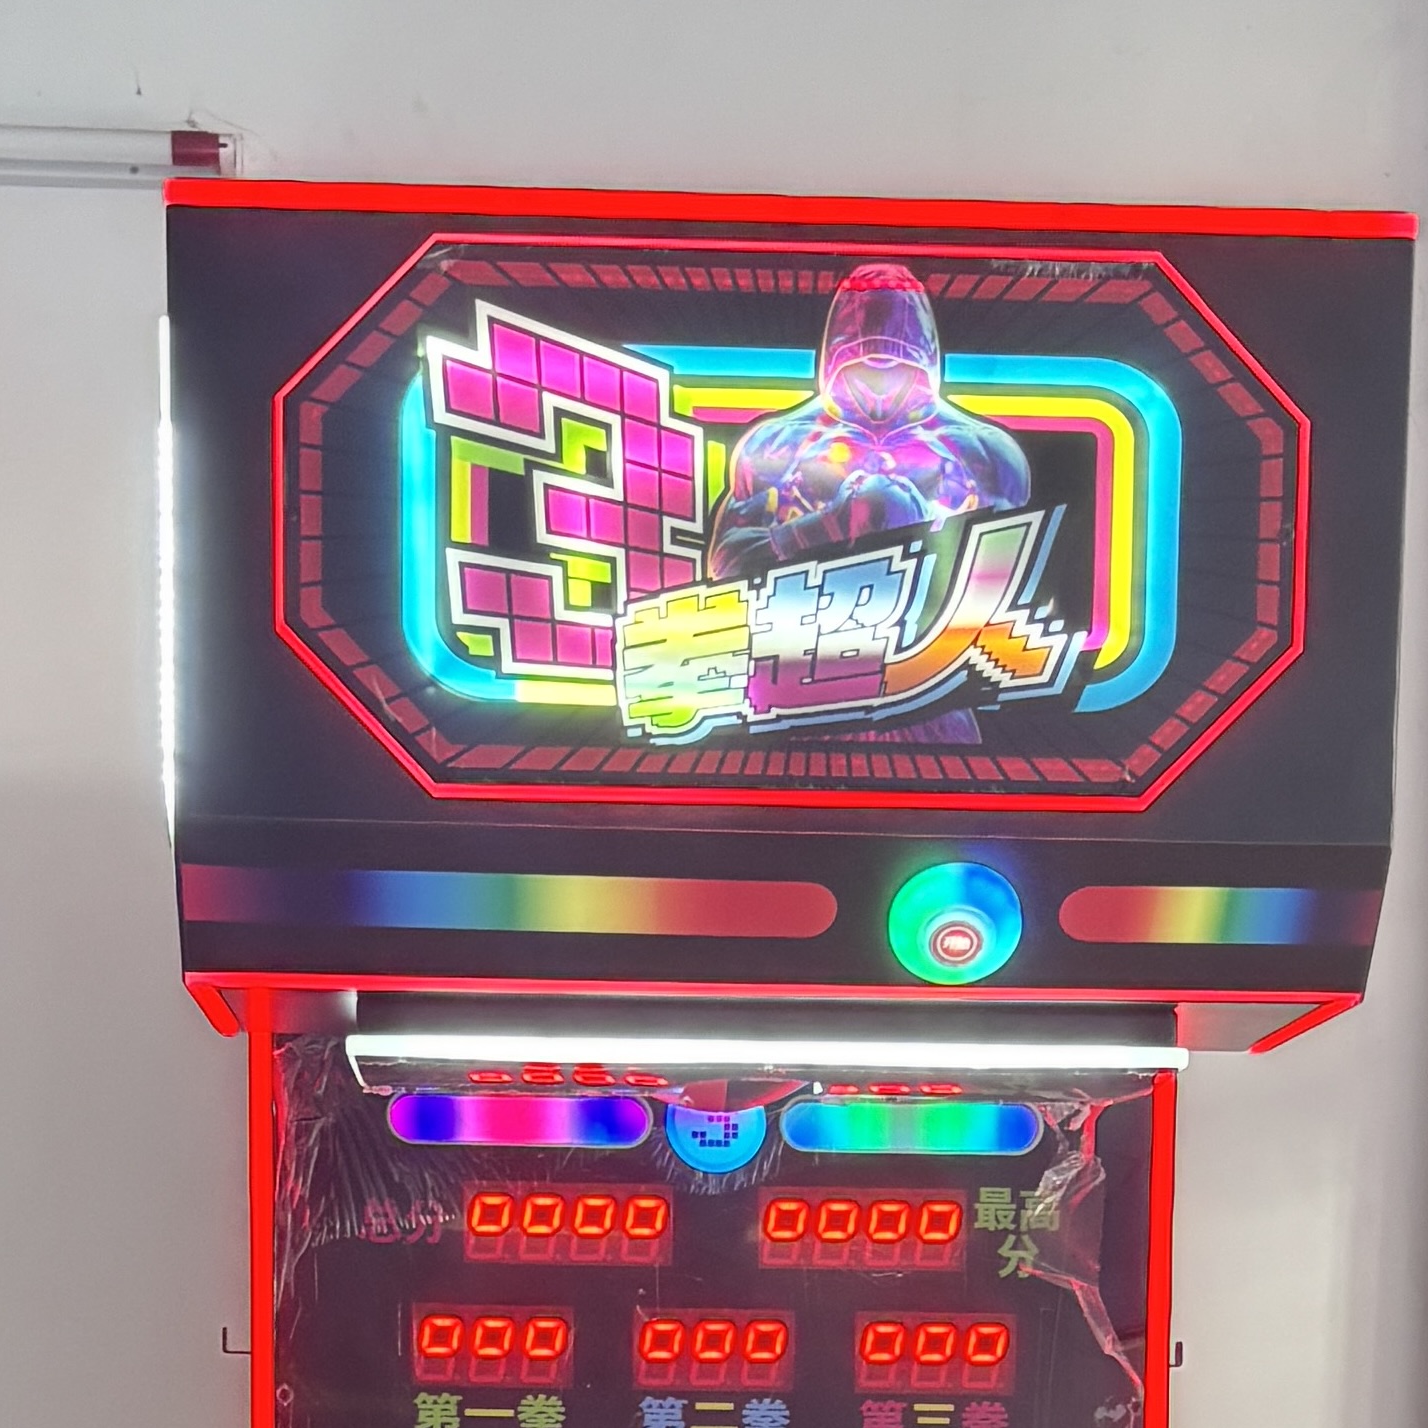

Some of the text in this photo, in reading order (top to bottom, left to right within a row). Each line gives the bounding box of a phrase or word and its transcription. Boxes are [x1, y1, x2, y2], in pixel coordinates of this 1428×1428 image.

[615, 506, 1074, 744] 拳超人
[997, 1234, 1040, 1278] 分
